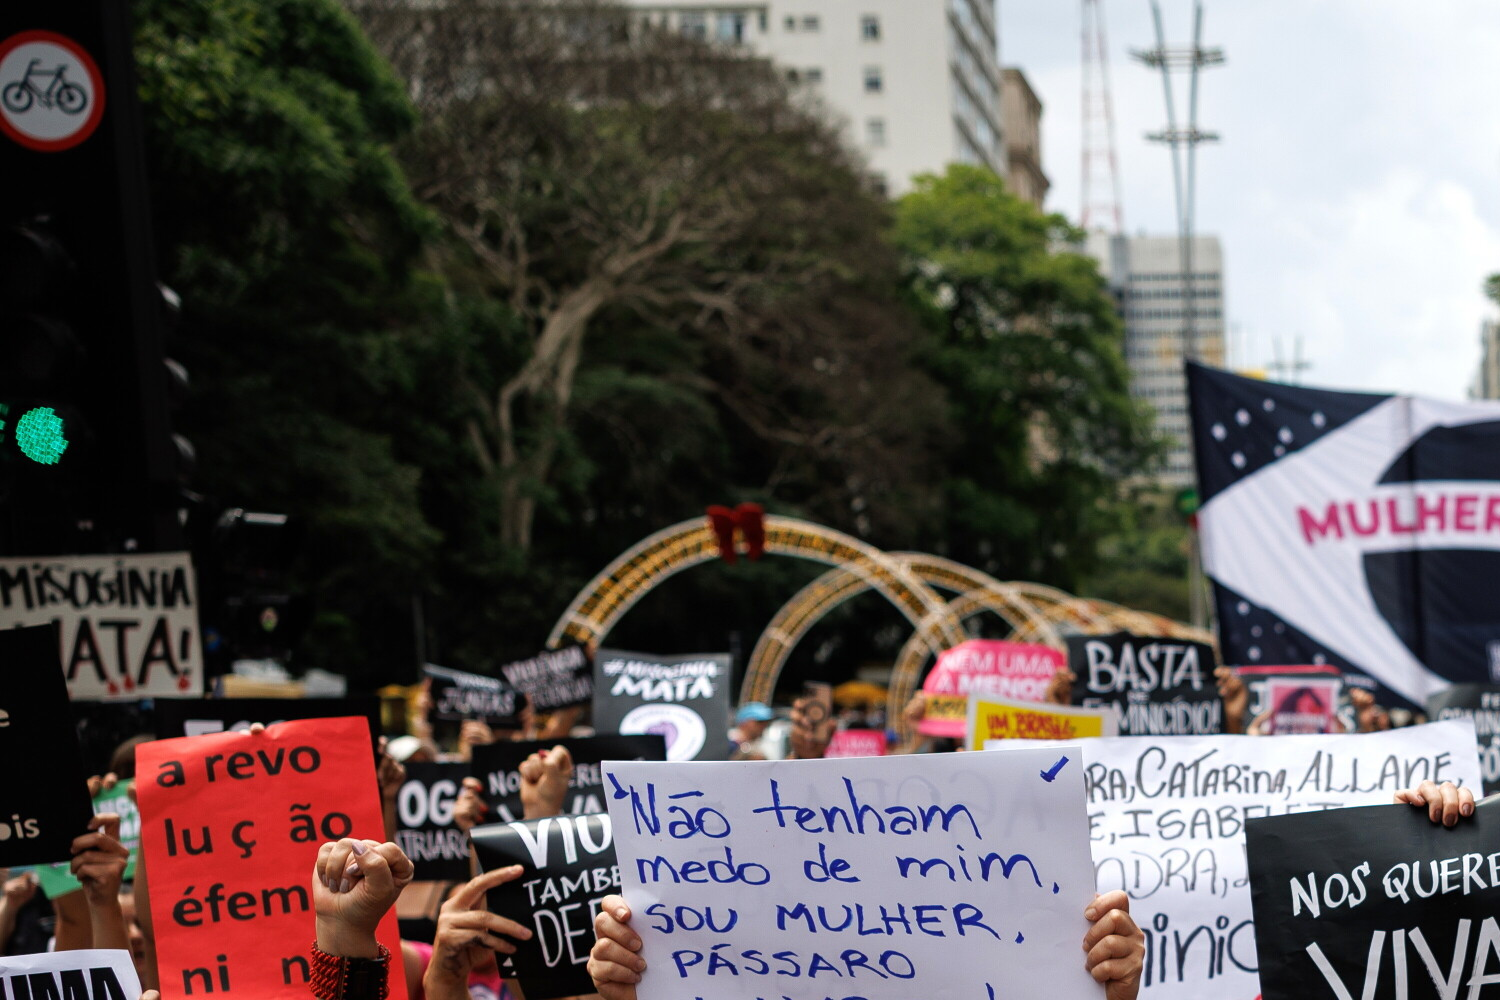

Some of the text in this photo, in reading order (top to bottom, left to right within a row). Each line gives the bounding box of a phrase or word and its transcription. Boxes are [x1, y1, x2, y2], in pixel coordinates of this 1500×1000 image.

[51, 614, 190, 686] ATA!
[1085, 640, 1207, 693] BASTA
[610, 675, 714, 701] MATA
[156, 745, 322, 788] a revo
[1084, 761, 1136, 803] RA,
[752, 776, 982, 839] tenham
[164, 803, 353, 859] lu ç ão
[636, 846, 771, 885] medo
[803, 843, 860, 884] de
[172, 882, 310, 927] éfem
[1289, 861, 1371, 919] NOS
[646, 902, 738, 934] SOU
[182, 953, 231, 996] ni
[672, 942, 916, 980] PÁSSARO
